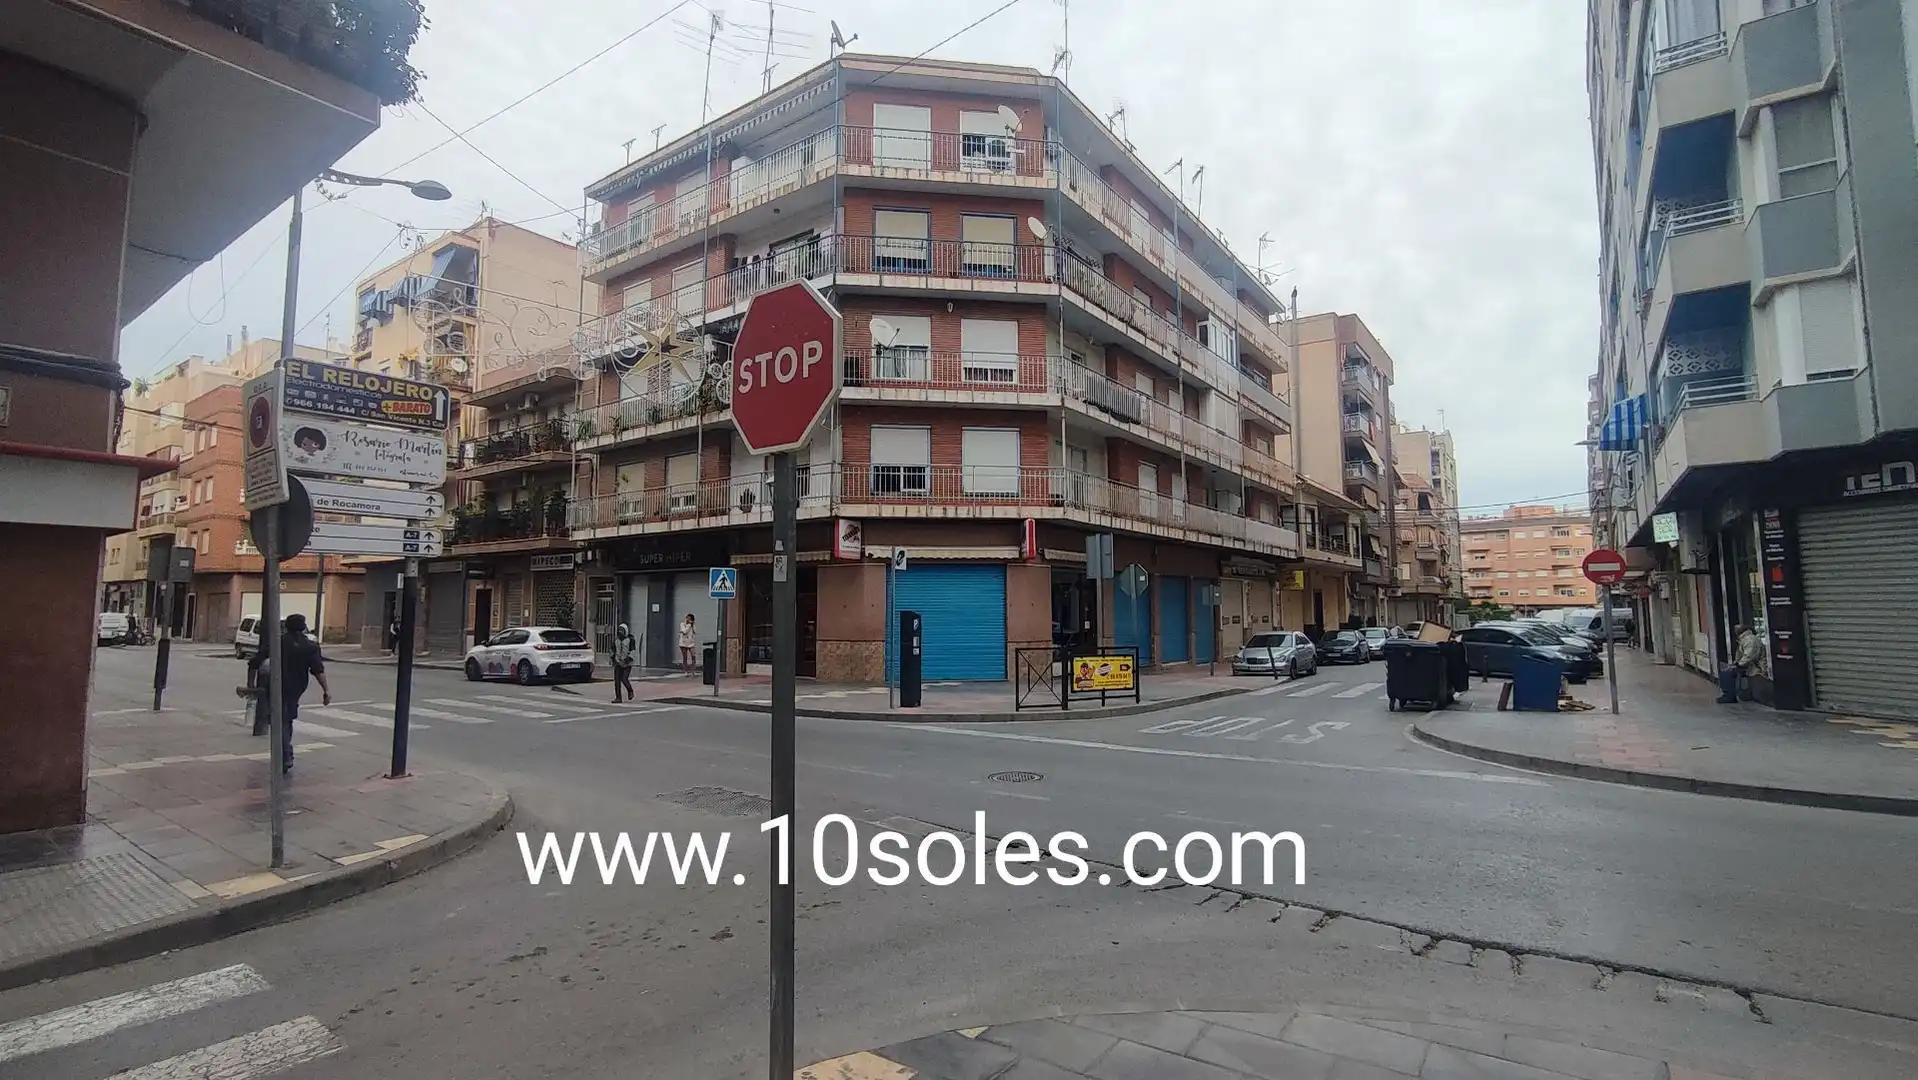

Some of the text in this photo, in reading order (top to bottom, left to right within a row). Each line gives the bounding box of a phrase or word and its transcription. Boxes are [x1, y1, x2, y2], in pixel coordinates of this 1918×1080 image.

[738, 340, 823, 394] STOP
[287, 361, 433, 400] EL RELOJERO
[337, 405, 355, 414] 444
[388, 413, 417, 424] Vicente
[317, 498, 381, 511] de Rocamora
[639, 552, 663, 565] SUPER
